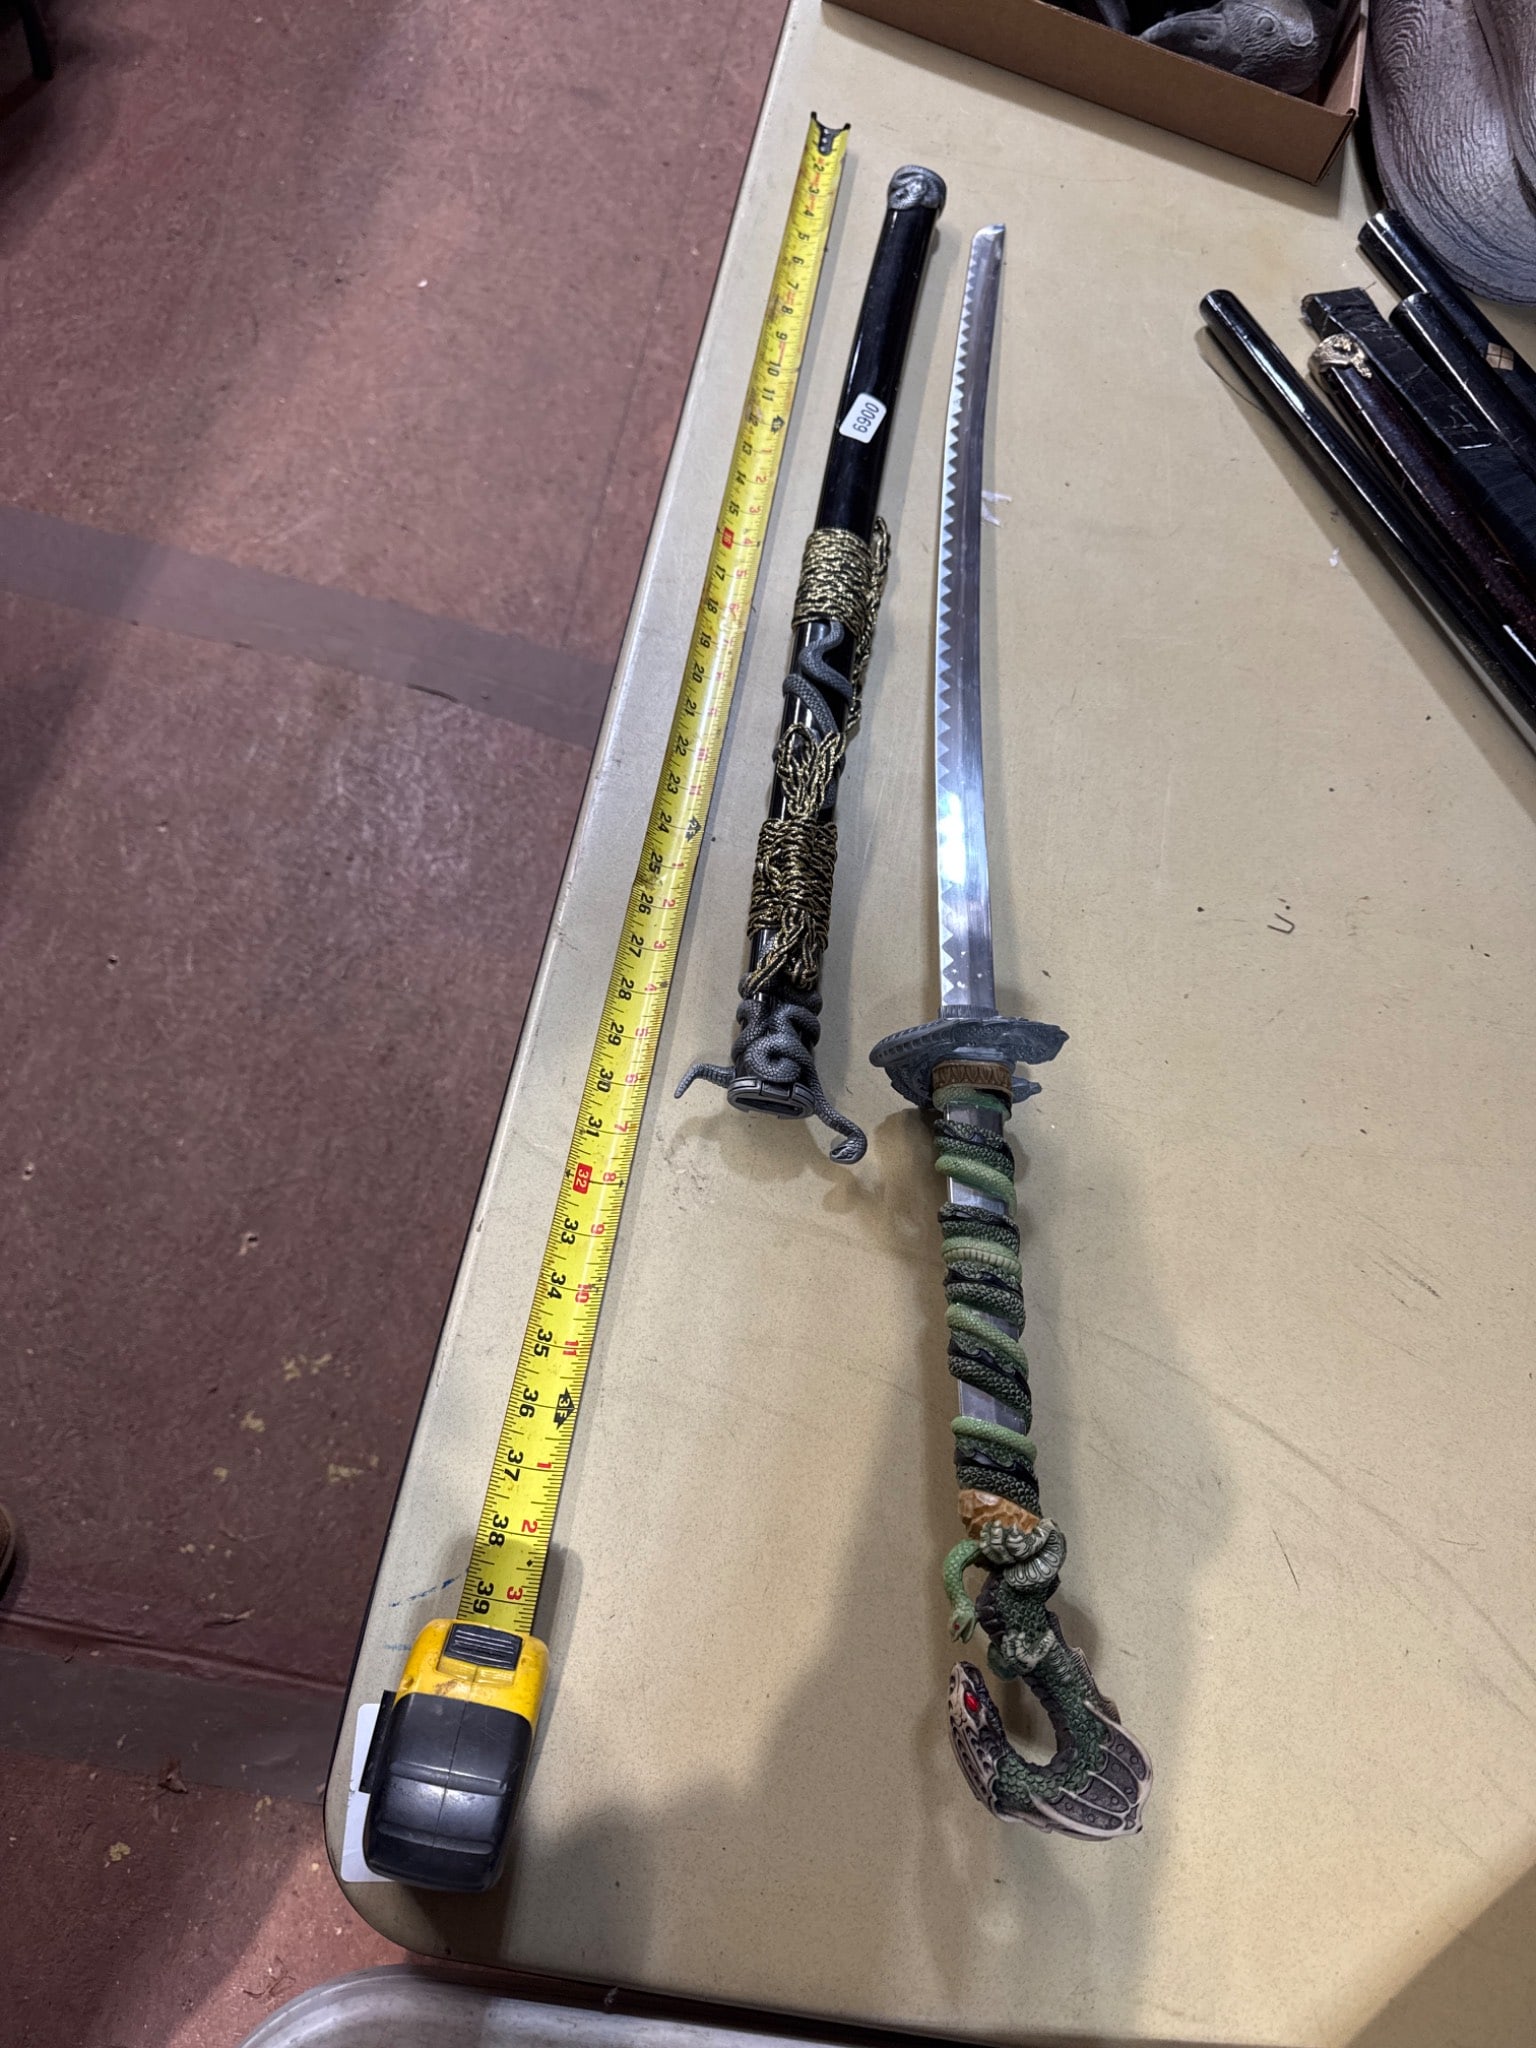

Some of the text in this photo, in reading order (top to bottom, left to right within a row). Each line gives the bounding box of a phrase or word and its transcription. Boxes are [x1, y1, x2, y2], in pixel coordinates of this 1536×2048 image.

[808, 186, 820, 195] 3
[797, 232, 810, 241] 5
[791, 256, 804, 265] 6
[787, 281, 799, 290] 7
[781, 305, 794, 315] 8
[775, 331, 788, 340] 9
[767, 361, 781, 377] 10
[762, 387, 775, 401] 11
[742, 441, 753, 456] 13
[734, 470, 747, 486] 14
[728, 500, 740, 517] 15
[749, 505, 762, 515] 3
[715, 564, 726, 581] 17
[707, 598, 719, 614] 18
[700, 631, 712, 649] 19
[692, 662, 705, 684] 20
[684, 697, 697, 717] 21
[675, 735, 689, 756] 22
[666, 770, 681, 795] 23
[658, 809, 672, 834] 24
[648, 851, 663, 875] 25
[638, 892, 654, 916] 26
[662, 898, 676, 908] 2
[628, 933, 644, 958] 27
[653, 940, 667, 950] 3
[618, 976, 634, 1001] 28
[644, 983, 657, 992] 4
[608, 1021, 625, 1046] 29
[596, 1067, 614, 1093] 30
[585, 1115, 603, 1138] 31
[614, 1121, 630, 1132] 7
[574, 1167, 590, 1189] 32
[602, 1171, 617, 1182] 8
[560, 1217, 579, 1245] 33
[590, 1223, 605, 1235] 9
[547, 1271, 567, 1300] 34
[575, 1283, 592, 1303] 10
[533, 1328, 553, 1359] 35
[562, 1340, 579, 1356] 11
[519, 1387, 539, 1419] 36
[556, 1396, 571, 1419] 3F
[504, 1449, 524, 1482] 37
[488, 1513, 509, 1547] 38
[521, 1519, 538, 1534] 2
[472, 1580, 494, 1615] 39
[506, 1586, 523, 1601] 3
